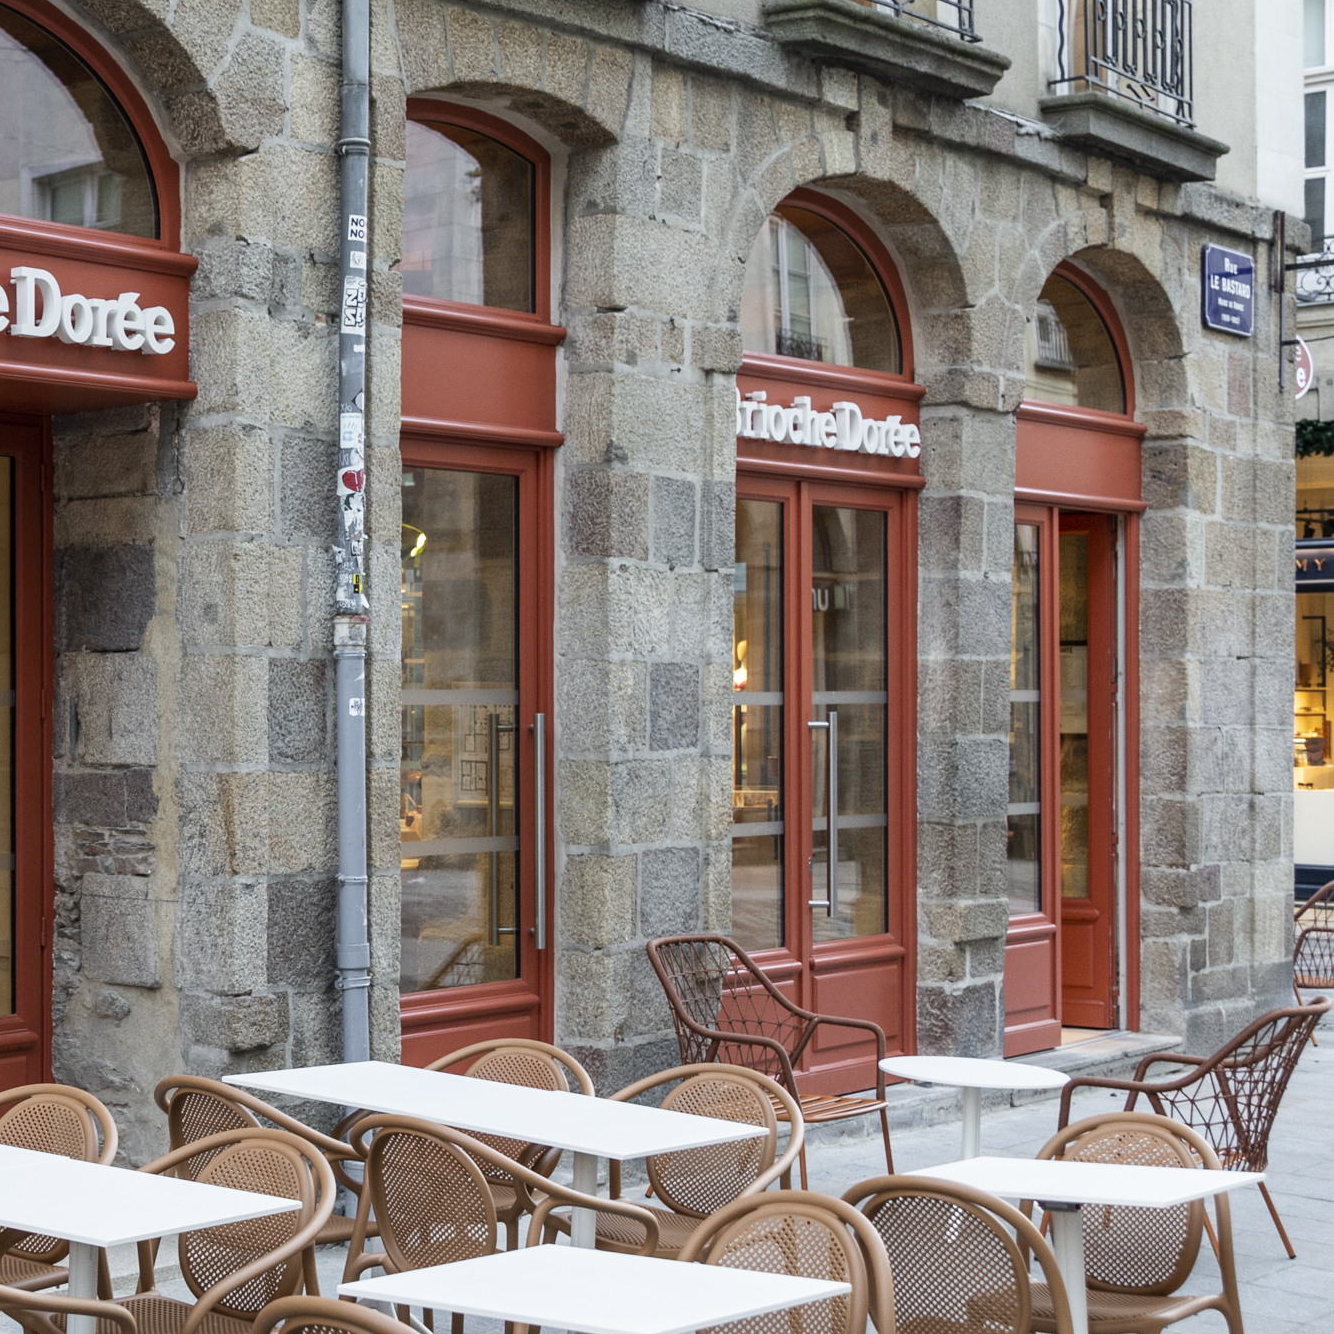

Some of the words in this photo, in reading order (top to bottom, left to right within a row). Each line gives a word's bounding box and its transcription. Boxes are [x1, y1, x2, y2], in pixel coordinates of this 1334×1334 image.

[10, 265, 176, 355] Dorée
[1210, 274, 1220, 290] LE
[1221, 277, 1251, 299] BASTARD
[736, 387, 837, 448] rioche
[832, 400, 921, 459] Dorée
